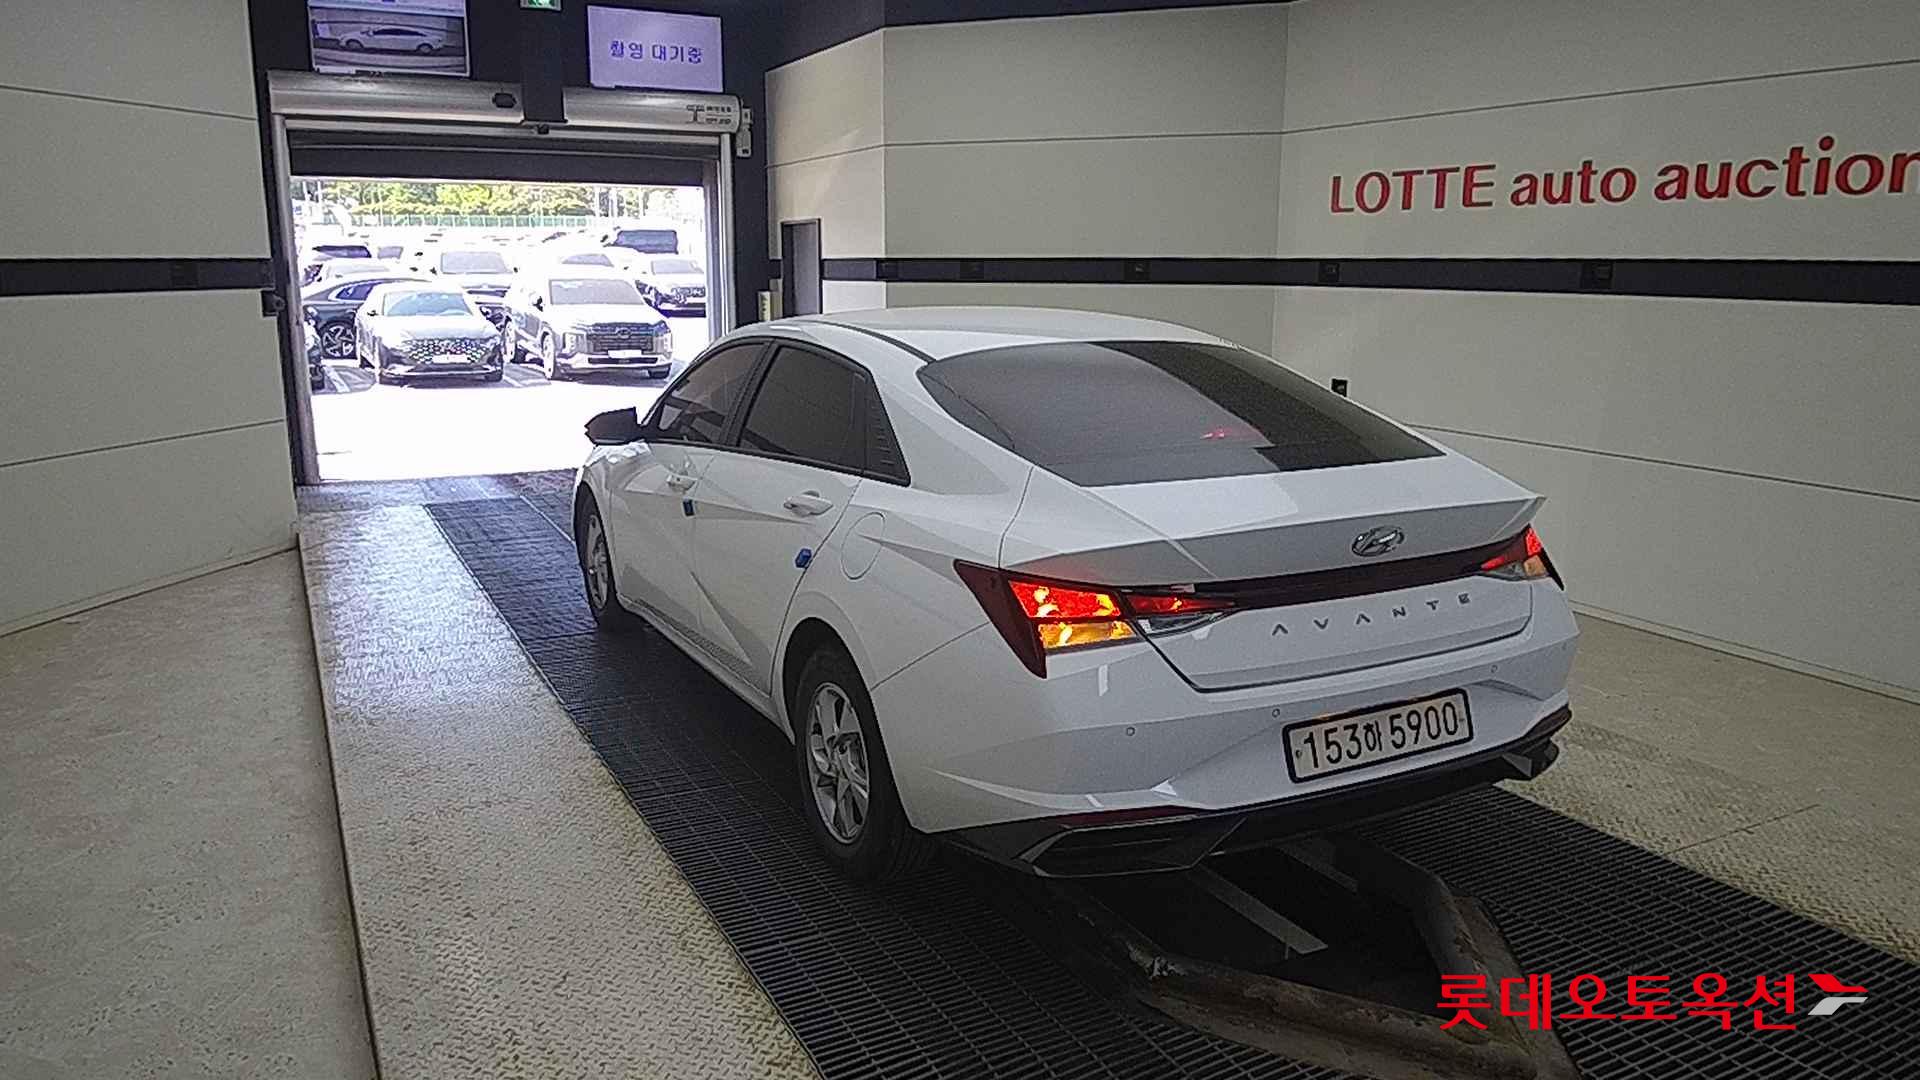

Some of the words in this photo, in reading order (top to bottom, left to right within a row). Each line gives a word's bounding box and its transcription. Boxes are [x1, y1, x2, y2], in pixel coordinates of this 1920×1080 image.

[610, 40, 643, 60] 촬영
[652, 44, 702, 64] 대기중
[1330, 163, 1496, 214] LOTTE
[1510, 159, 1637, 206] auto
[1271, 592, 1471, 636] AVANTE
[1388, 701, 1459, 750] 5900
